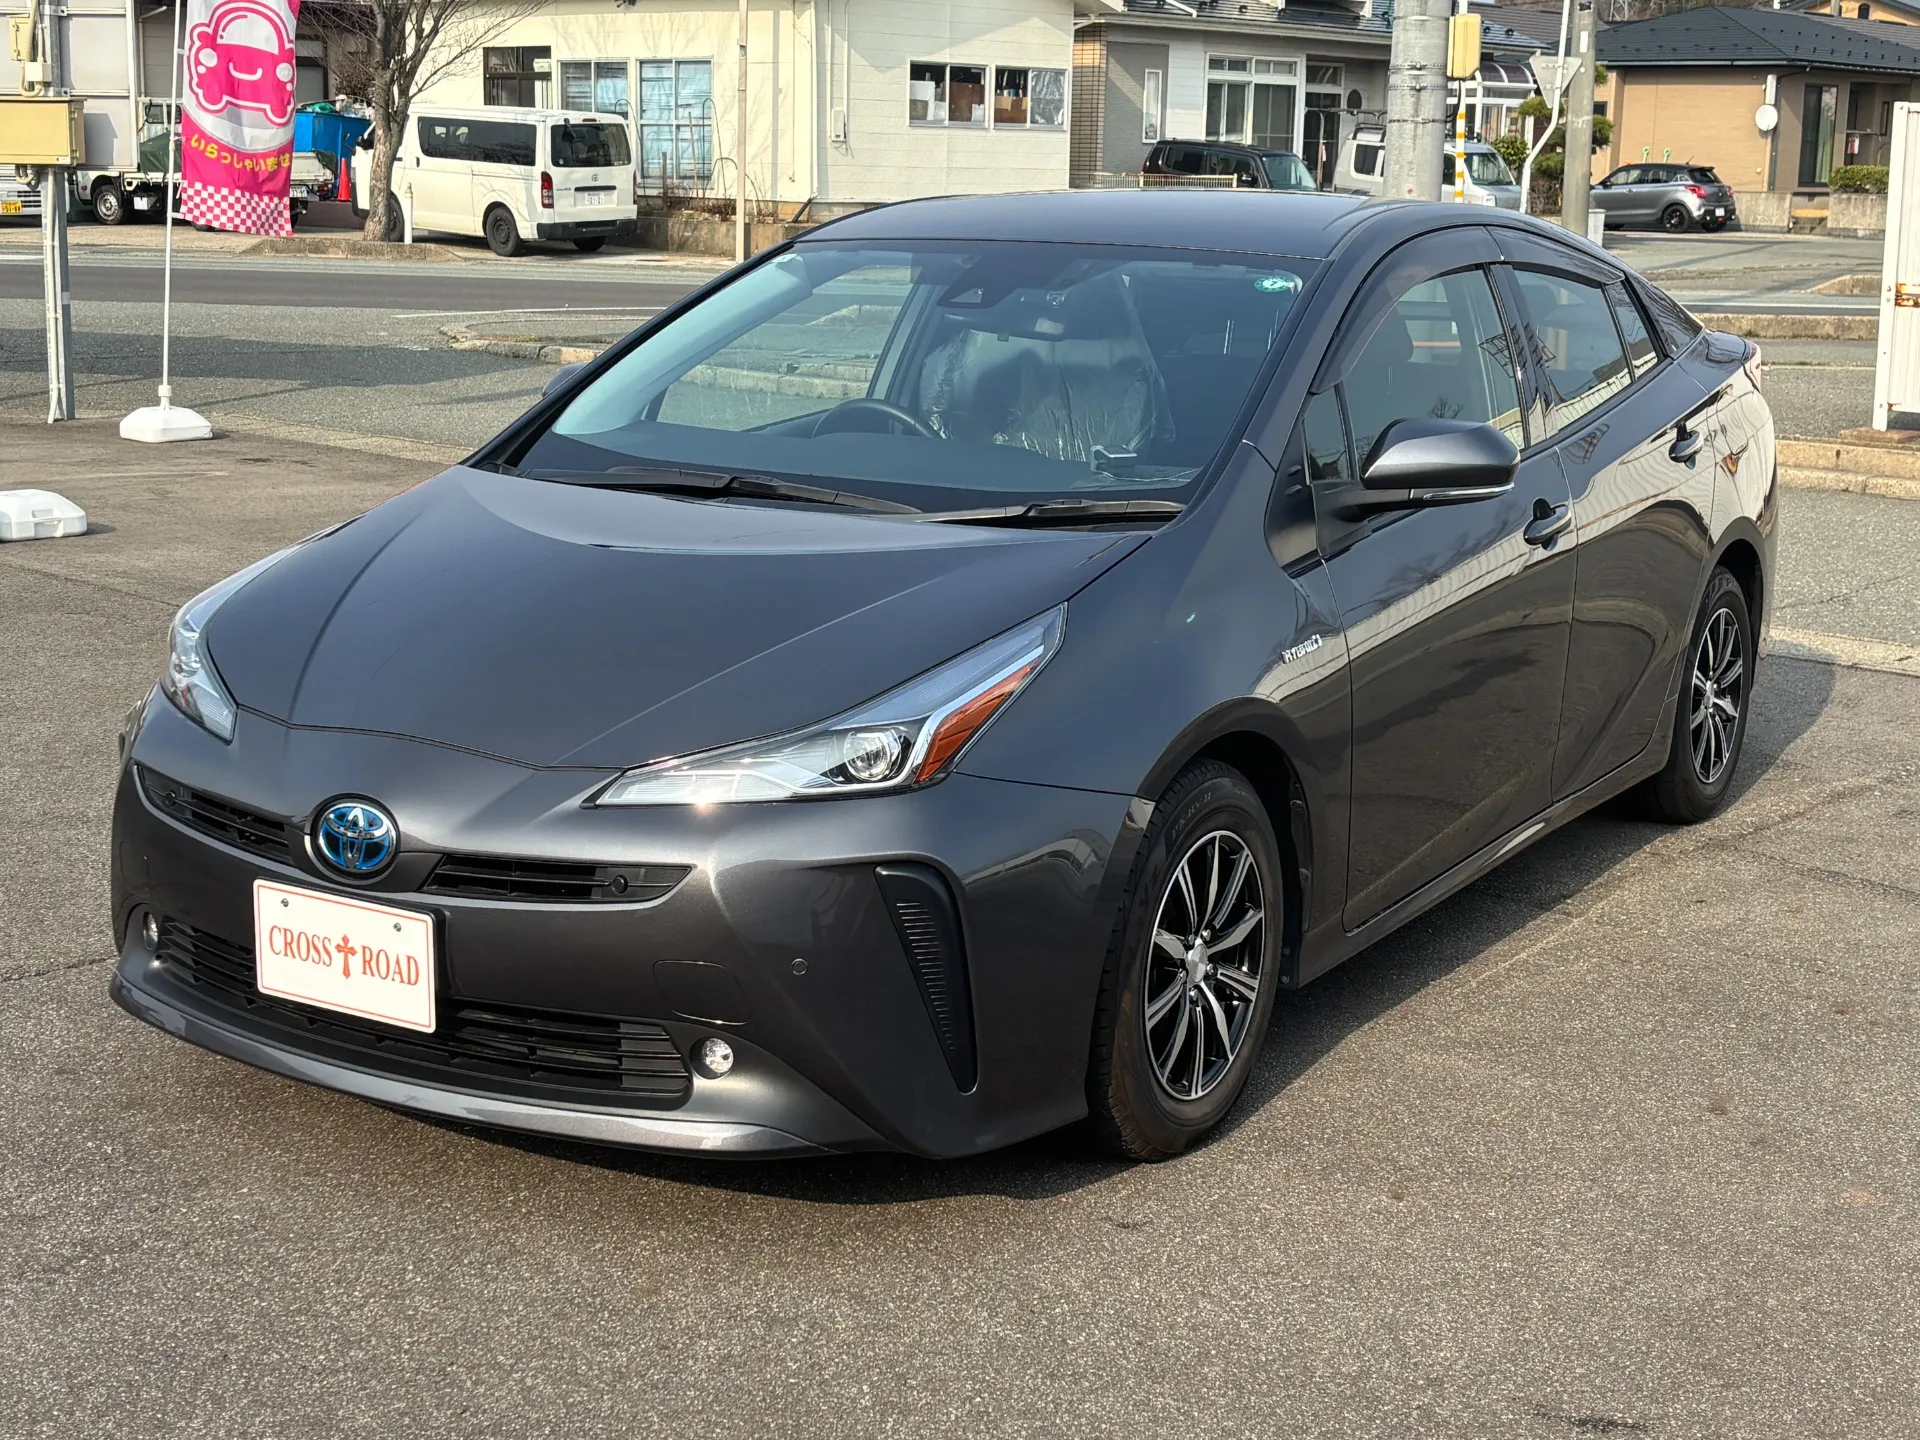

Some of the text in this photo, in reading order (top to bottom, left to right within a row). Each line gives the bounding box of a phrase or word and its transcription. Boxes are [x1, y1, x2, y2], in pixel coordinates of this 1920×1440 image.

[190, 133, 291, 172] いらっしゃいませ
[1282, 634, 1322, 663] HYBRID
[269, 925, 420, 987] CROSS ROAD
